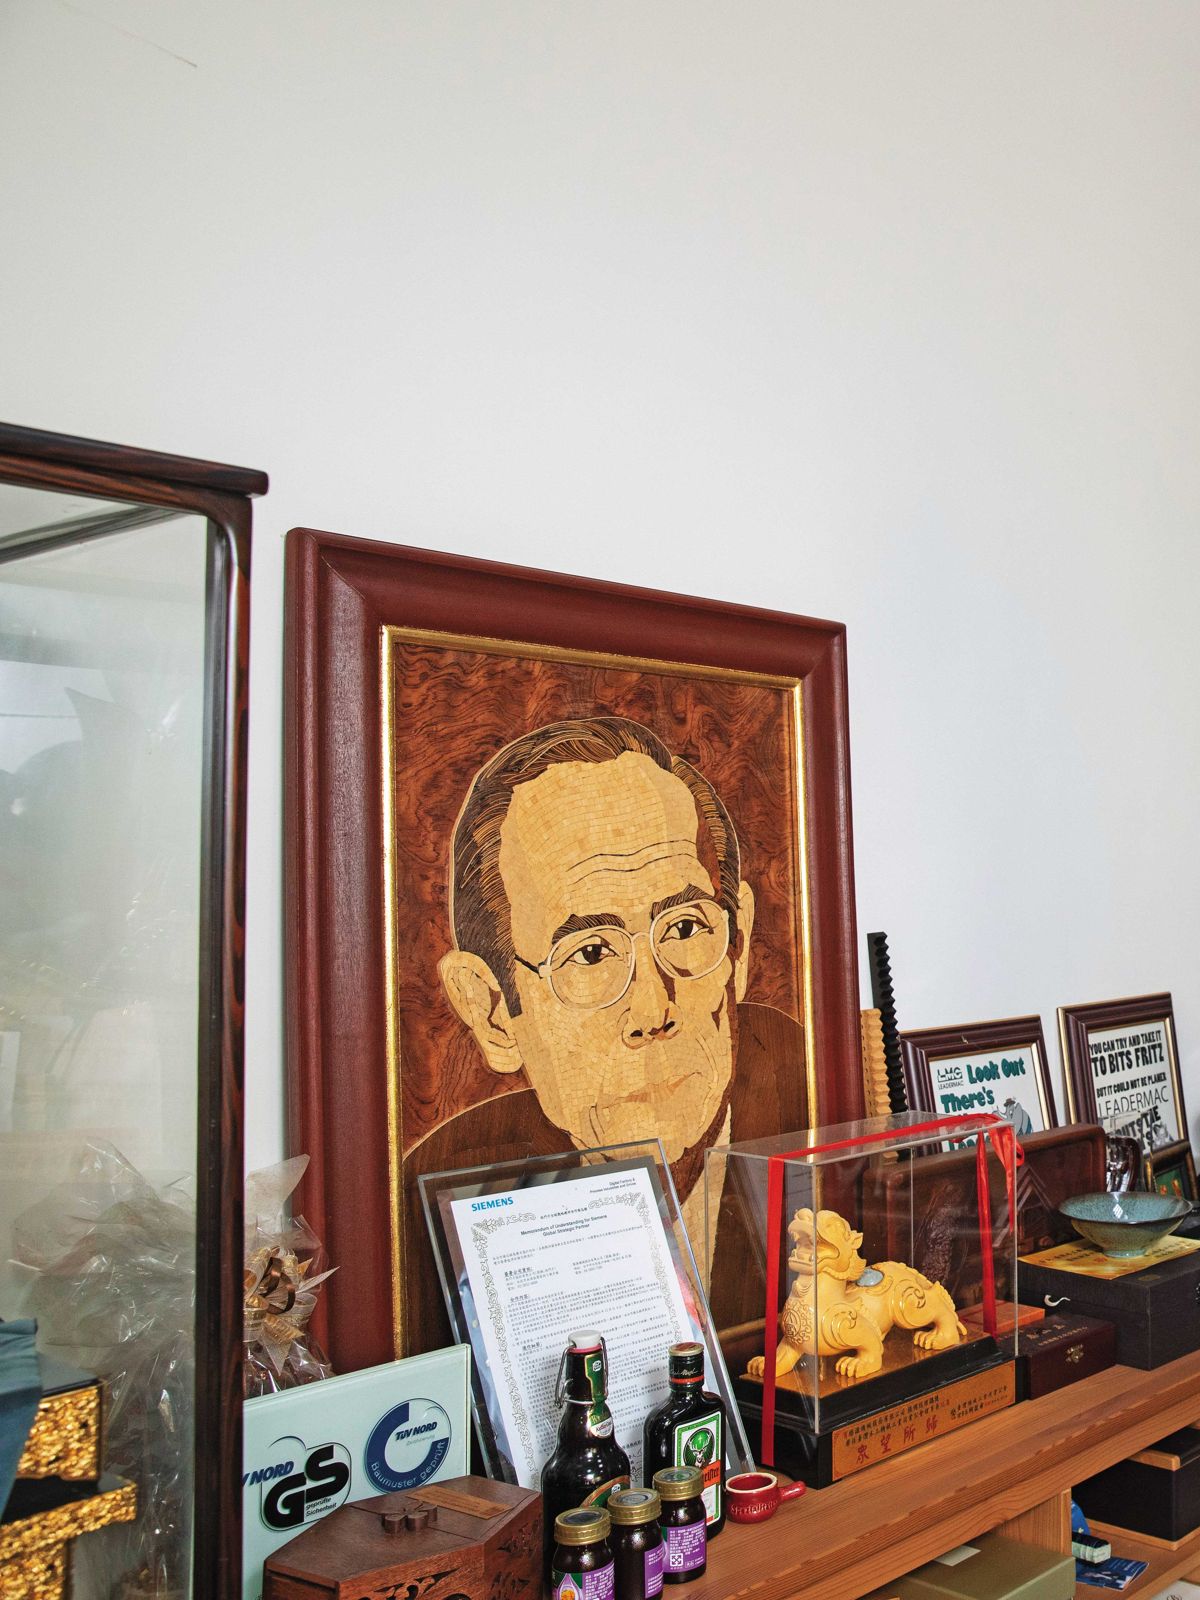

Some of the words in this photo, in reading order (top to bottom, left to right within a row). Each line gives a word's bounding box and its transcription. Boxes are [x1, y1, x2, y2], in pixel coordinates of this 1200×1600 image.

[1089, 1042, 1102, 1056] YOU
[1102, 1039, 1115, 1053] CAN
[1115, 1036, 1128, 1049] TRY
[1128, 1034, 1141, 1047] AND
[1141, 1031, 1155, 1044] TAKE
[1155, 1030, 1162, 1041] IT
[966, 1061, 1000, 1084] Look
[1001, 1057, 1026, 1078] Out
[1091, 1056, 1107, 1077] TO
[1108, 1050, 1133, 1074] BITS
[1134, 1042, 1165, 1068] FRITZ
[938, 1080, 964, 1090] LEADERMAC
[1096, 1086, 1107, 1098] BUT
[1107, 1085, 1113, 1095] IT
[1113, 1081, 1130, 1094] COULD
[940, 1086, 995, 1113] There's
[1098, 1085, 1169, 1117] LEADERMAC
[471, 1196, 514, 1212] SIEMENS
[396, 1428, 413, 1441] TÜV
[412, 1421, 438, 1436] NORD
[249, 1461, 295, 1486] NORD
[371, 1461, 417, 1488] Baumuster
[420, 1441, 446, 1480] geprüft
[263, 1445, 350, 1528] GS
[305, 1497, 332, 1511] geprüfte
[305, 1502, 337, 1517] Sicherheit
